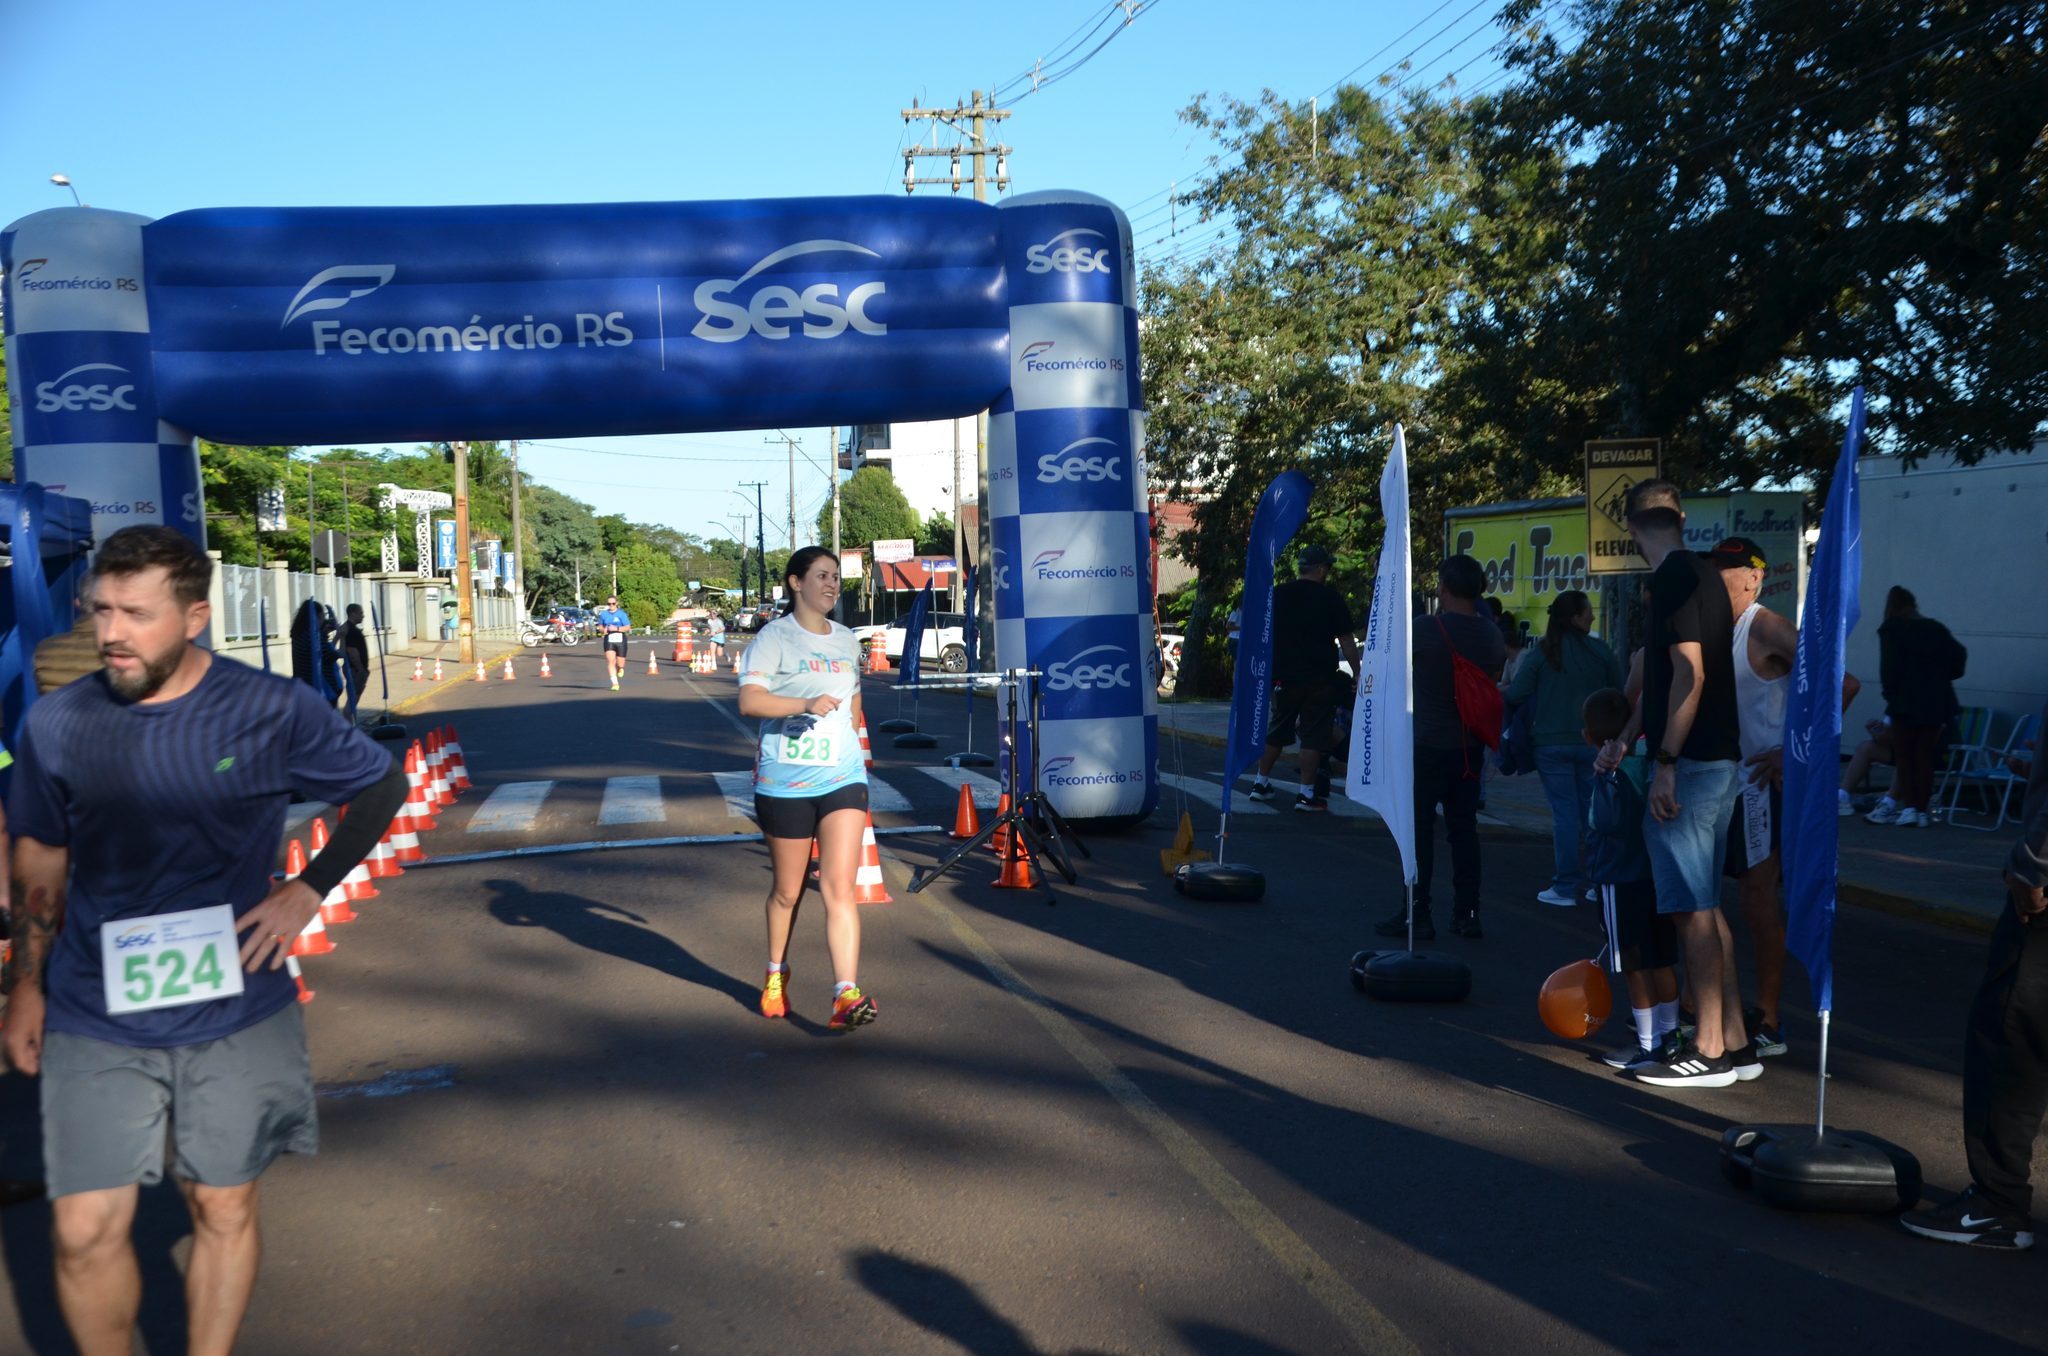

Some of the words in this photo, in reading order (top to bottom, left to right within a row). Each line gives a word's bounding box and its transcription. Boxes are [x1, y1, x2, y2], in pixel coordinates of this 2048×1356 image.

[23, 276, 112, 291] Fecomércio
[116, 278, 139, 292] RS
[312, 313, 563, 355] Fecomércio
[576, 311, 633, 348] RS
[1027, 357, 1107, 372] Fecomércio
[1110, 358, 1124, 371] RS
[1592, 449, 1653, 463] DEVAGAR
[1000, 467, 1013, 480] RS
[90, 500, 130, 515] ércio
[135, 501, 157, 514] RS
[1682, 523, 1726, 542] ruck
[1595, 539, 1643, 557] ELEVA
[1038, 566, 1117, 580] Fecomércio
[1120, 565, 1135, 578] RS
[1384, 616, 1394, 654] Sistema
[1256, 660, 1266, 677] RS
[1363, 673, 1374, 695] RS
[1250, 679, 1265, 746] Fecomércio
[786, 736, 831, 761] 528
[1361, 698, 1373, 786] Fecomércio
[1049, 772, 1126, 786] Fecomércio
[1129, 770, 1143, 782] RS
[124, 942, 225, 1002] 524
